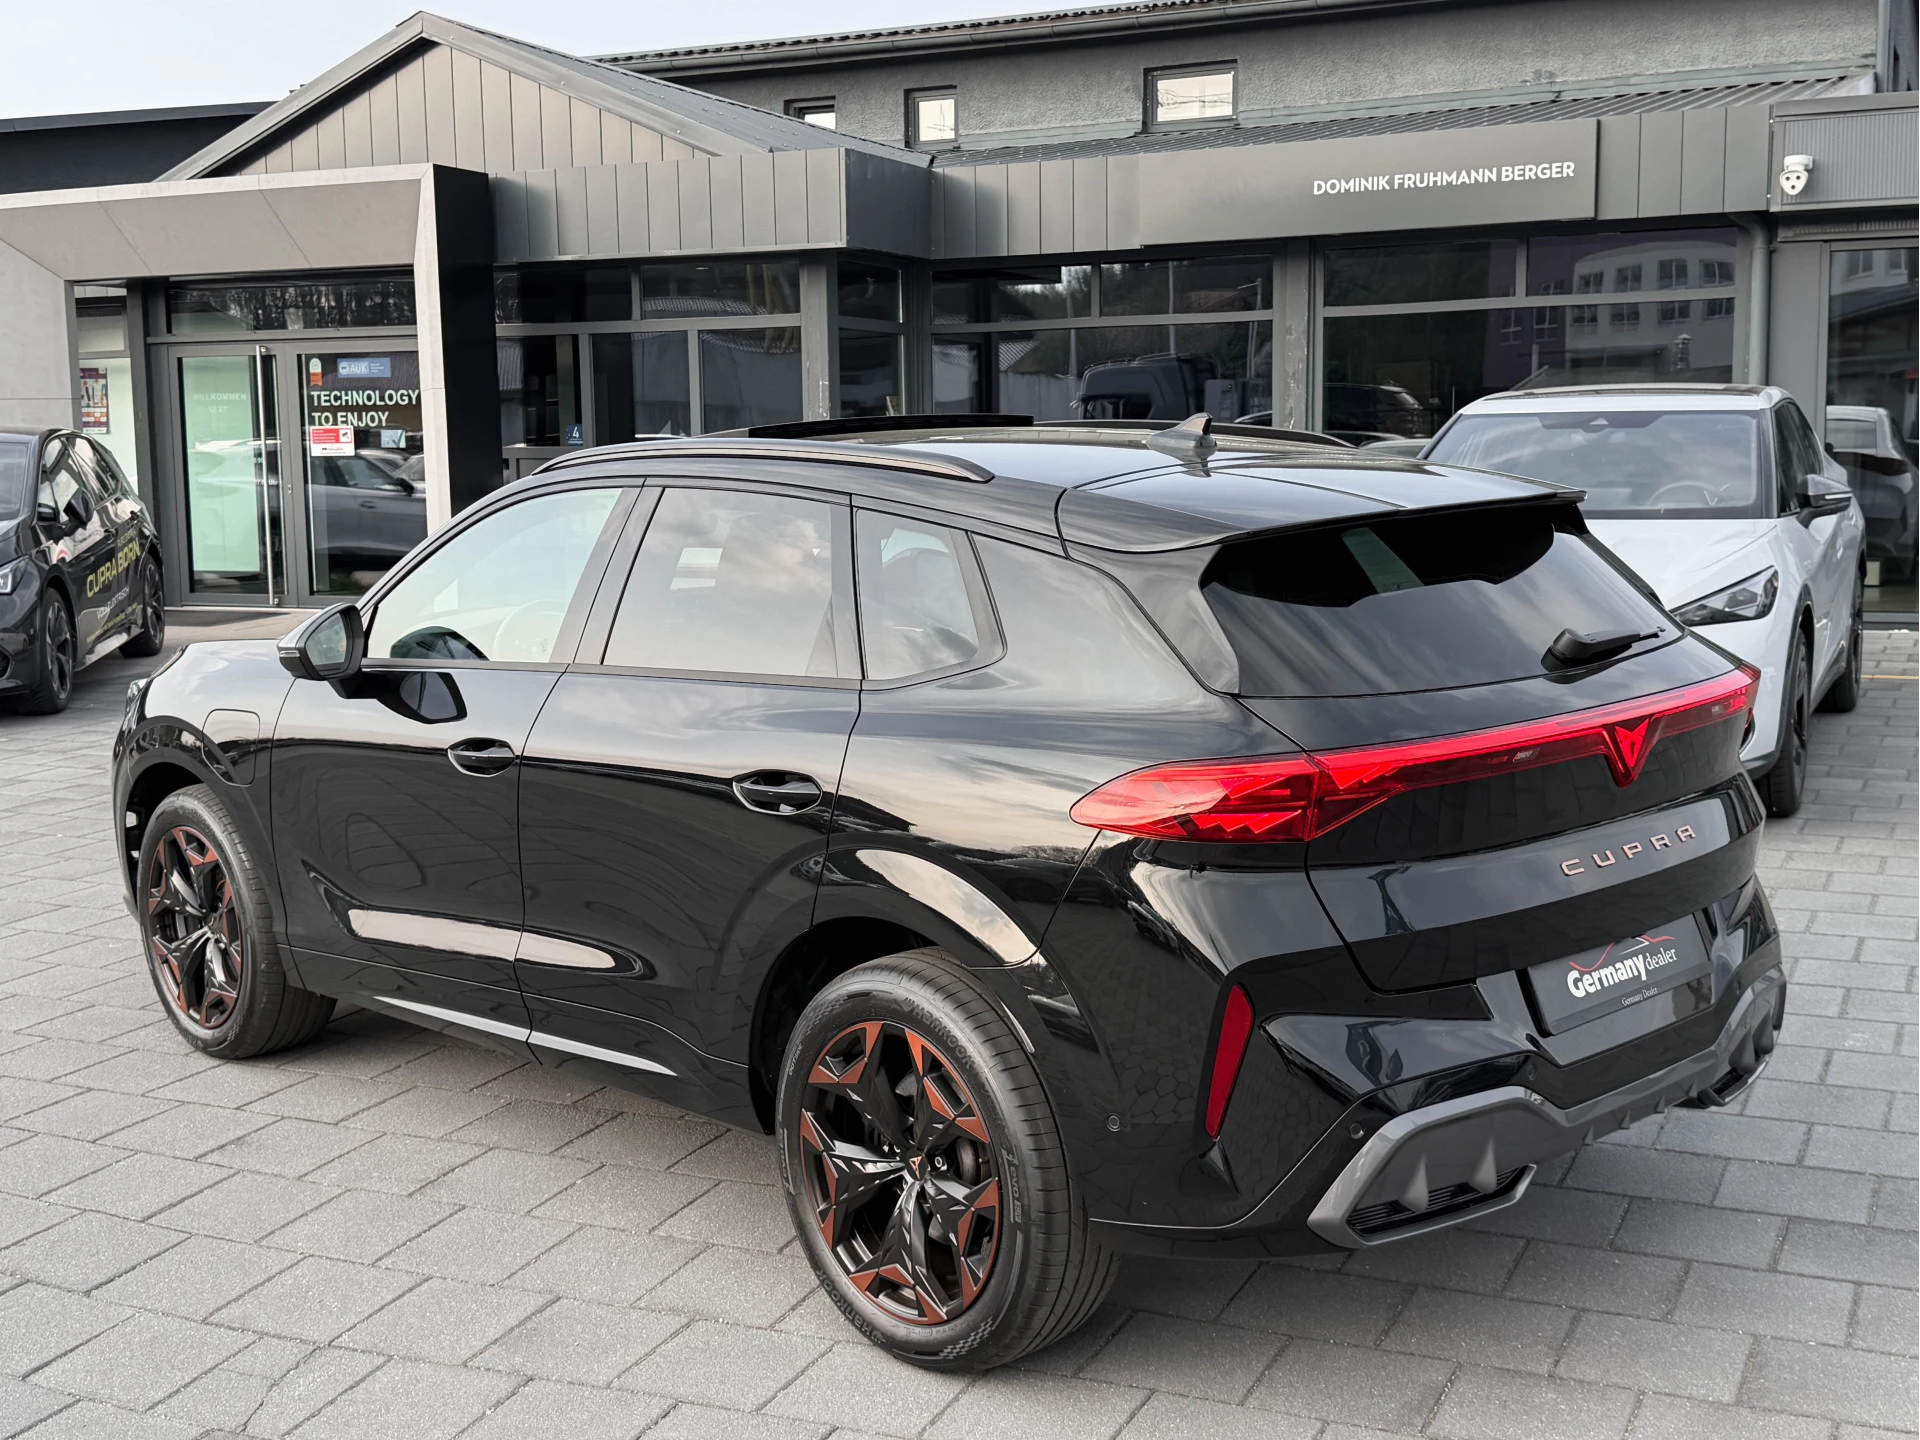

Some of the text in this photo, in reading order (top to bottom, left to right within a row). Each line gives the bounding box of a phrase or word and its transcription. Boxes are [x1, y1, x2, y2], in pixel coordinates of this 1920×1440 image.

[1313, 161, 1575, 195] DOMINIK FRUHMANN BERGER
[349, 362, 367, 374] AUK
[310, 389, 419, 406] TECHNOLOGY
[311, 411, 389, 427] TO ENJOY
[572, 426, 580, 439] 4
[87, 537, 140, 597] CUPRA BORN
[1560, 825, 1697, 876] CUPRA
[1566, 947, 1678, 999] Germany dealer
